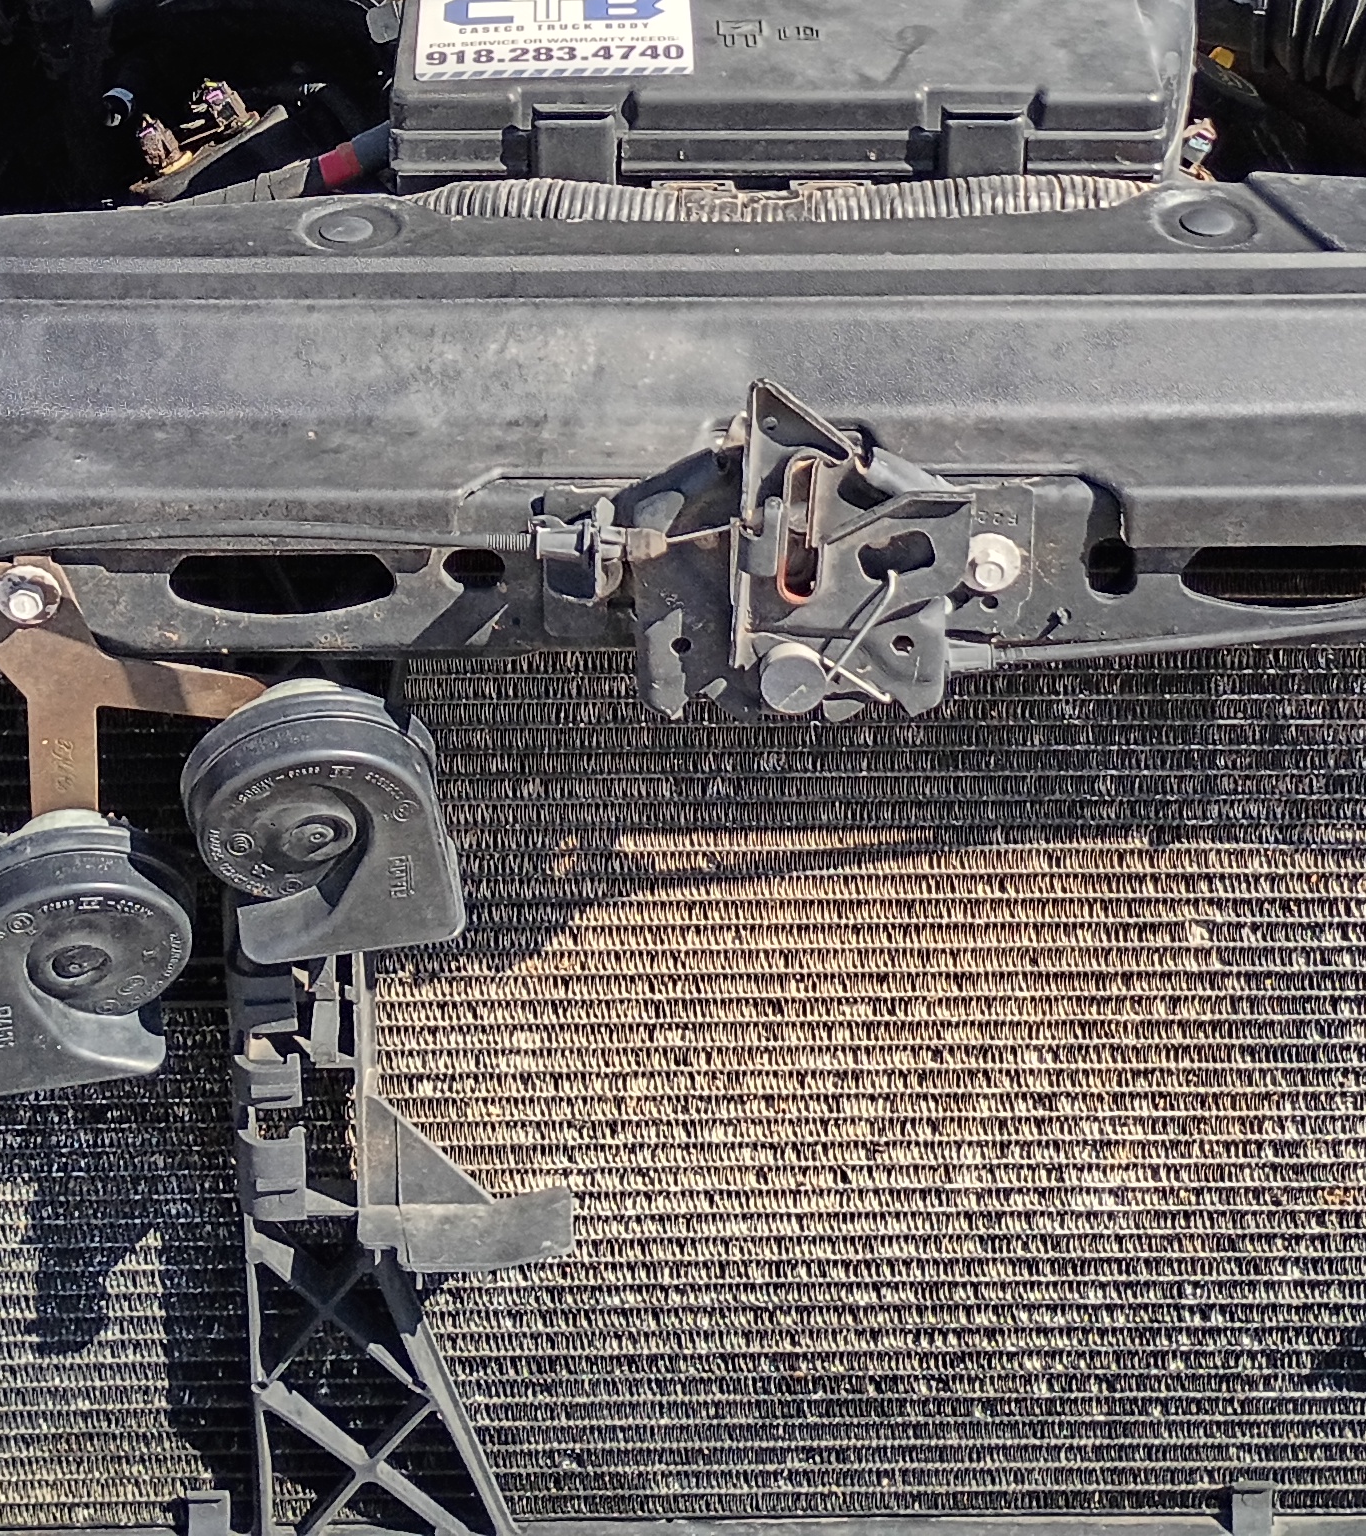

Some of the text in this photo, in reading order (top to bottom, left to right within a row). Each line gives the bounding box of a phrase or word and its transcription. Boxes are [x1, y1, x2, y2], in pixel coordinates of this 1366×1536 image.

[459, 22, 649, 35] CASECO TRUCK BODY
[461, 39, 519, 47] SERVICE
[425, 44, 684, 65] 918.283.4740
